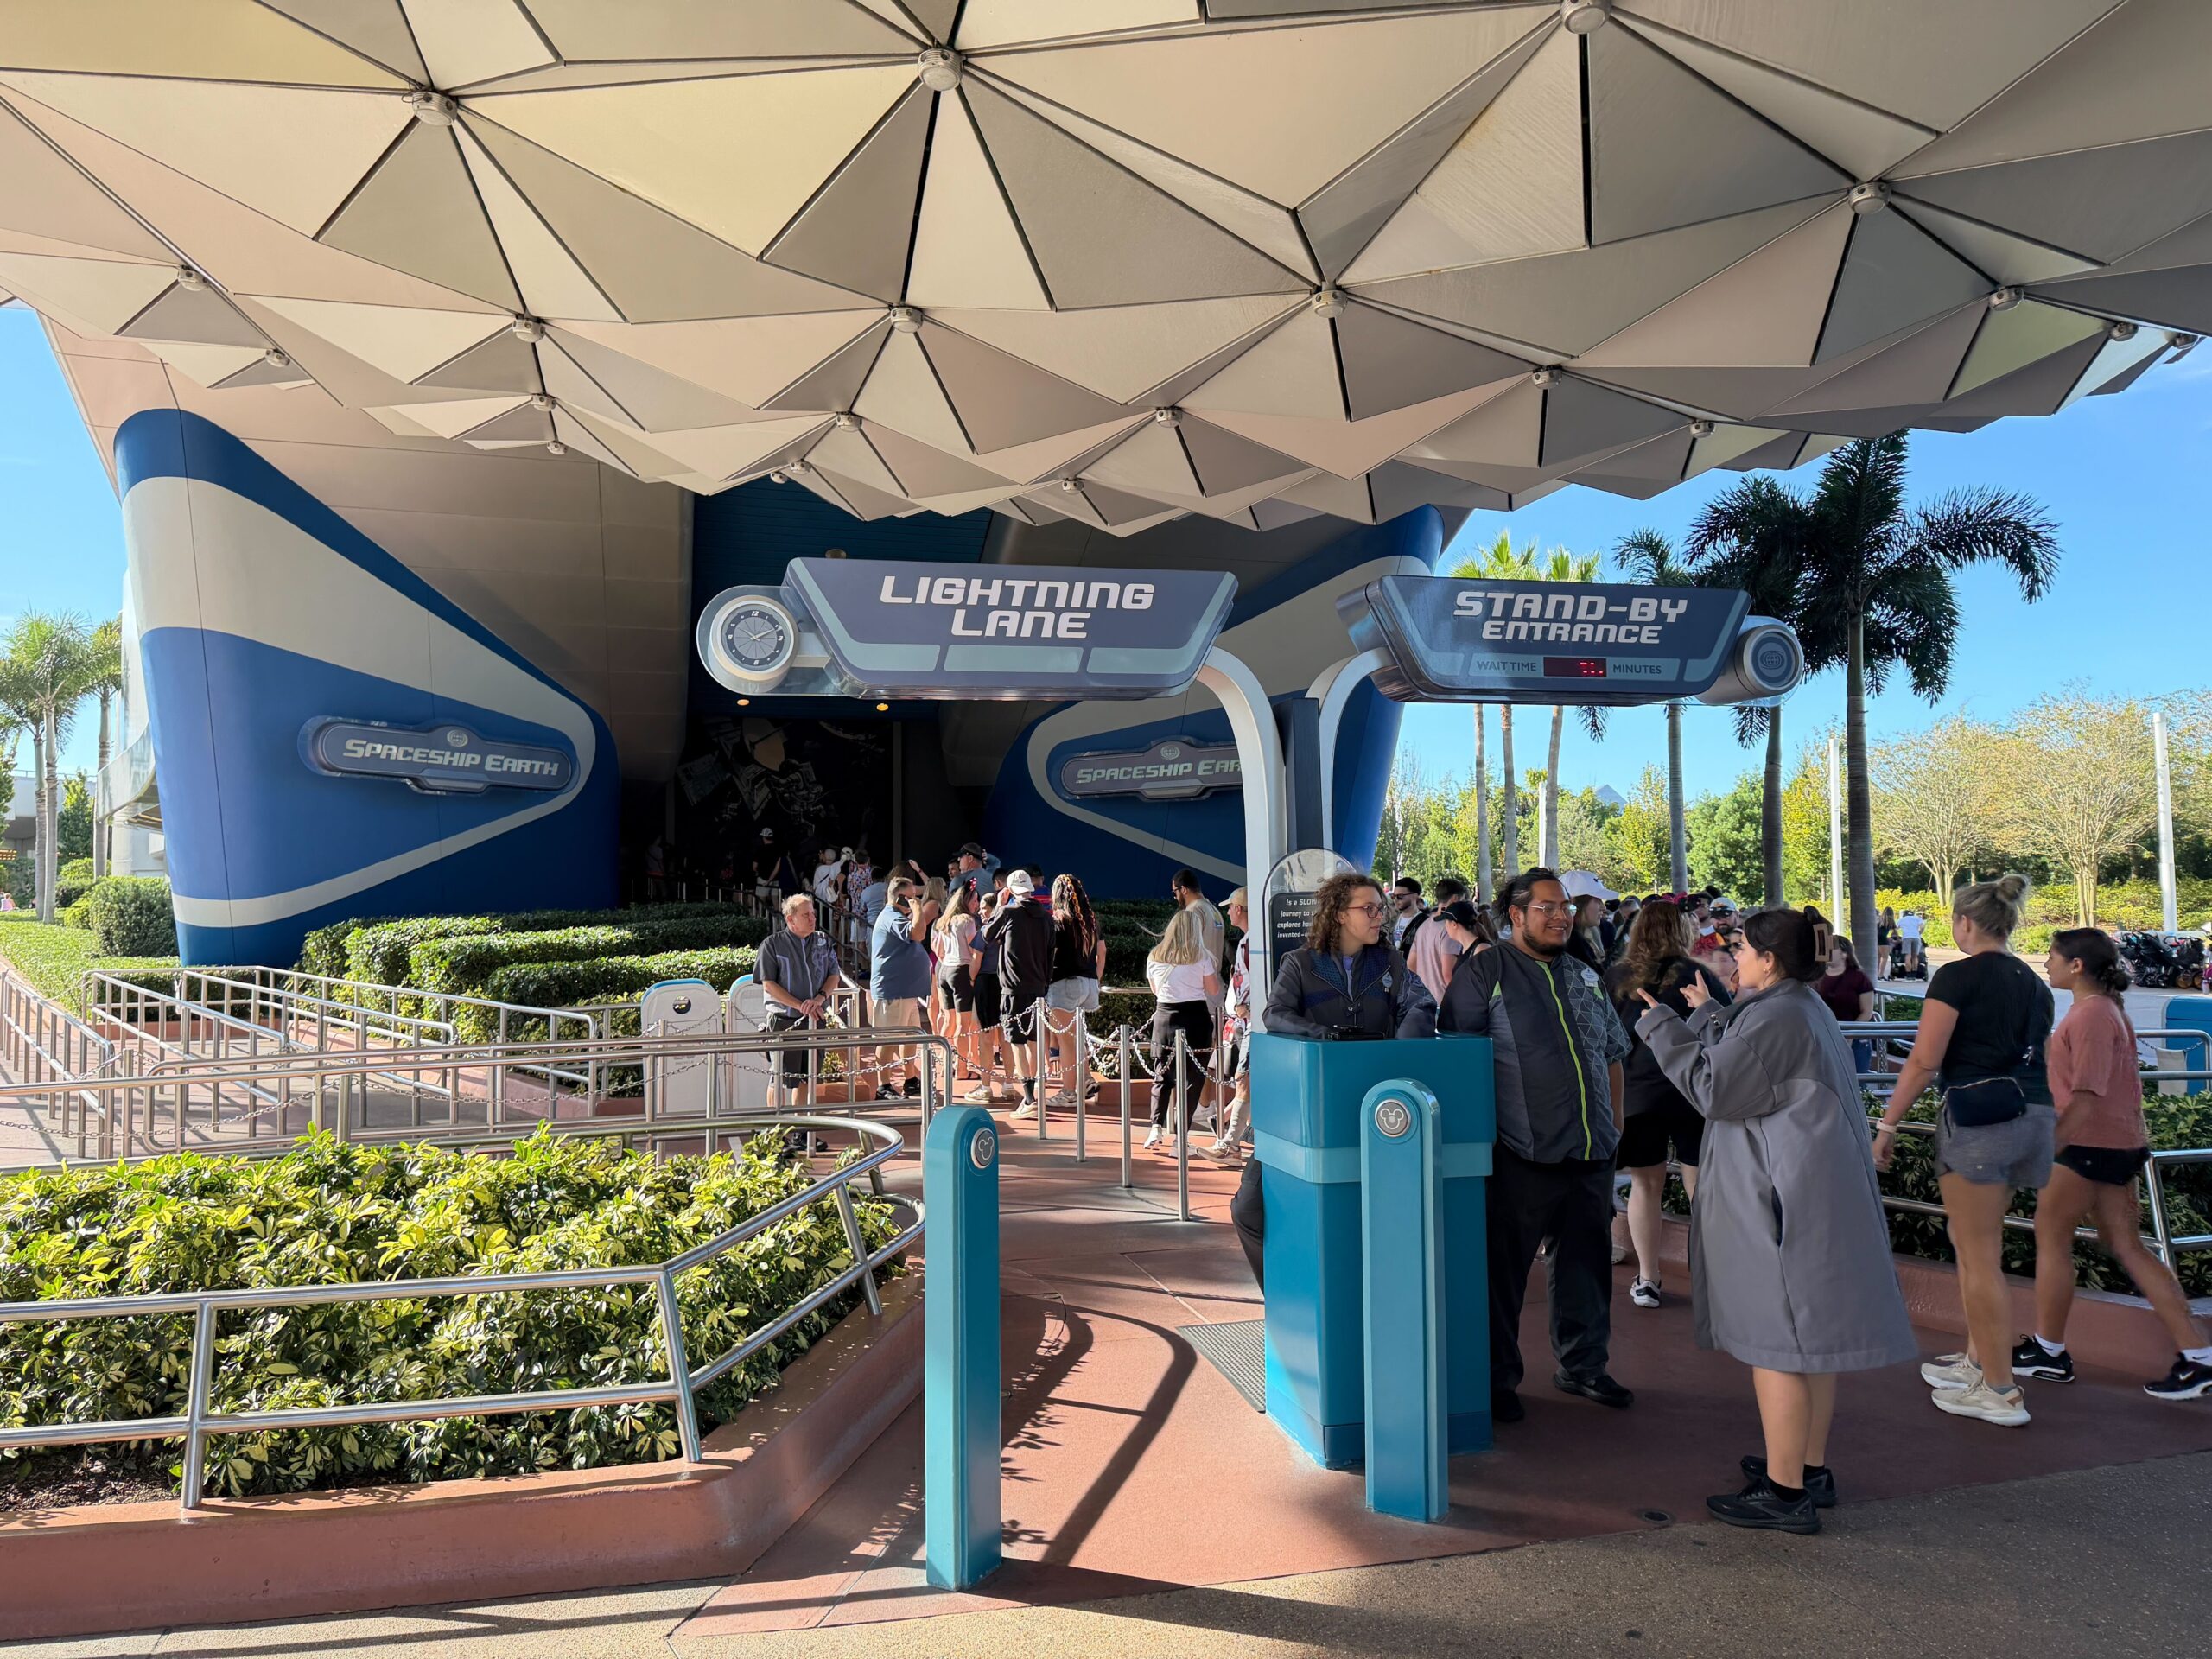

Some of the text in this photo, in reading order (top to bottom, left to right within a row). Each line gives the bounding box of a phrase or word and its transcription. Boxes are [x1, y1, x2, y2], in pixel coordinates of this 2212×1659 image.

[880, 575, 1155, 610] LIGHTNING
[1453, 591, 1688, 623] STAND-BY
[951, 608, 1091, 639] LANE
[1482, 620, 1662, 645] ENTRANCE
[1612, 664, 1662, 675] MINUTES
[343, 739, 559, 776] SPACESHIP EARTH
[1076, 760, 1241, 784] SPACESHIP EAR
[1277, 921, 1301, 930] explores
